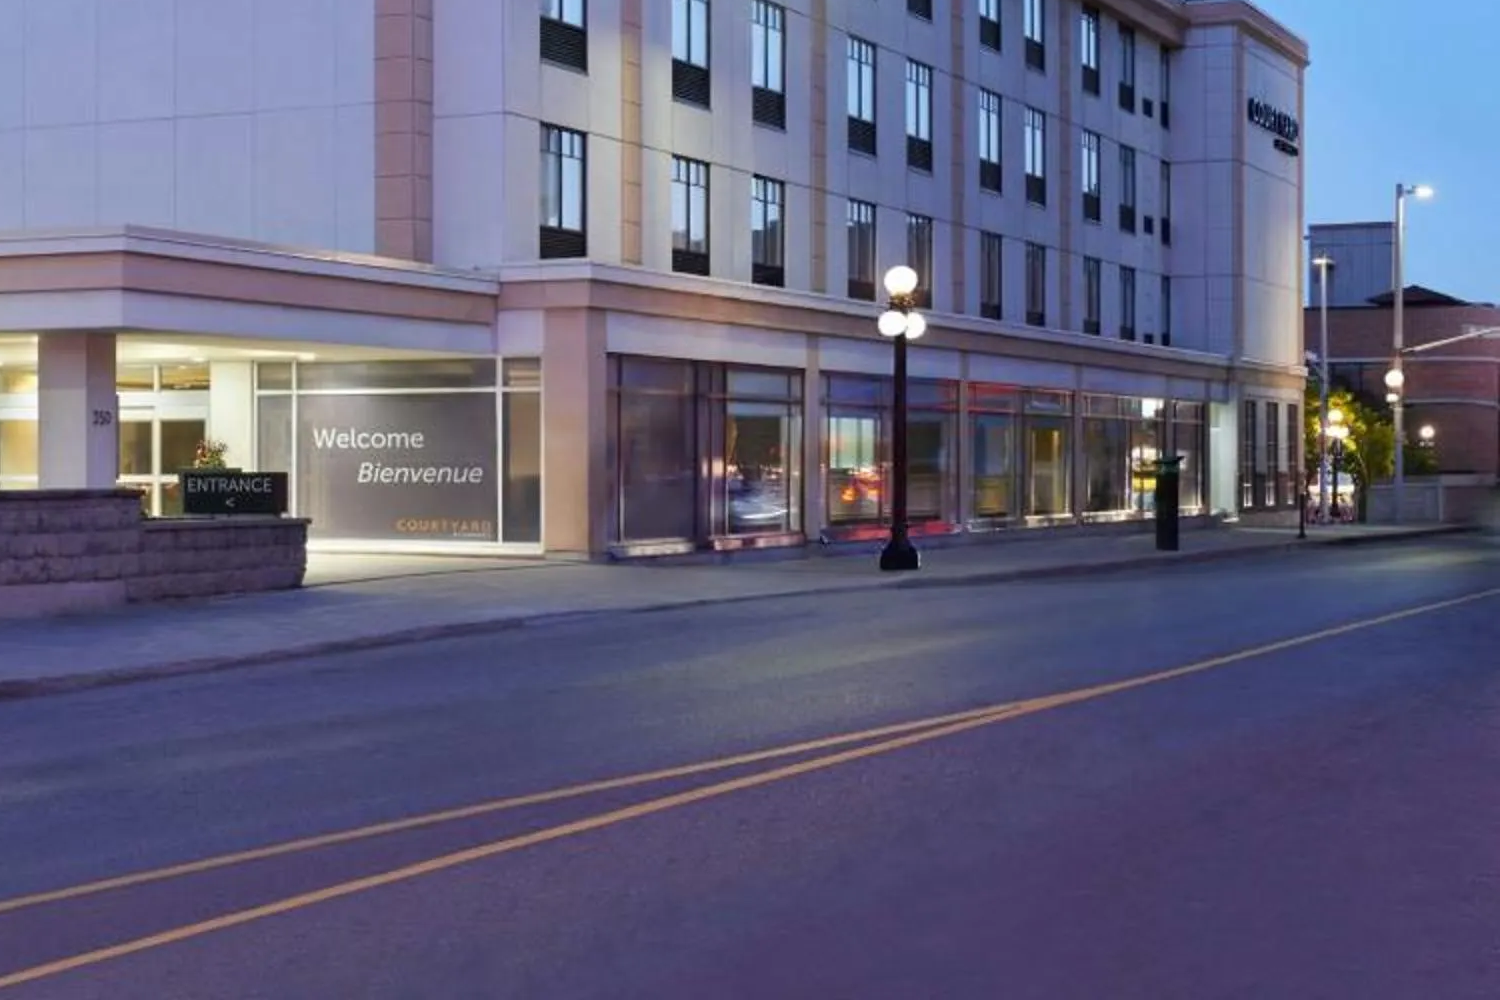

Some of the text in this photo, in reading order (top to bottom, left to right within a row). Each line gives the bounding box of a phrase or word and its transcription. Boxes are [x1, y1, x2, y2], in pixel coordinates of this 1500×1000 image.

[313, 428, 424, 448] Welcome
[357, 461, 483, 483] Bienvenue
[187, 477, 272, 493] ENTRANCE
[396, 518, 491, 533] COURTYARD
